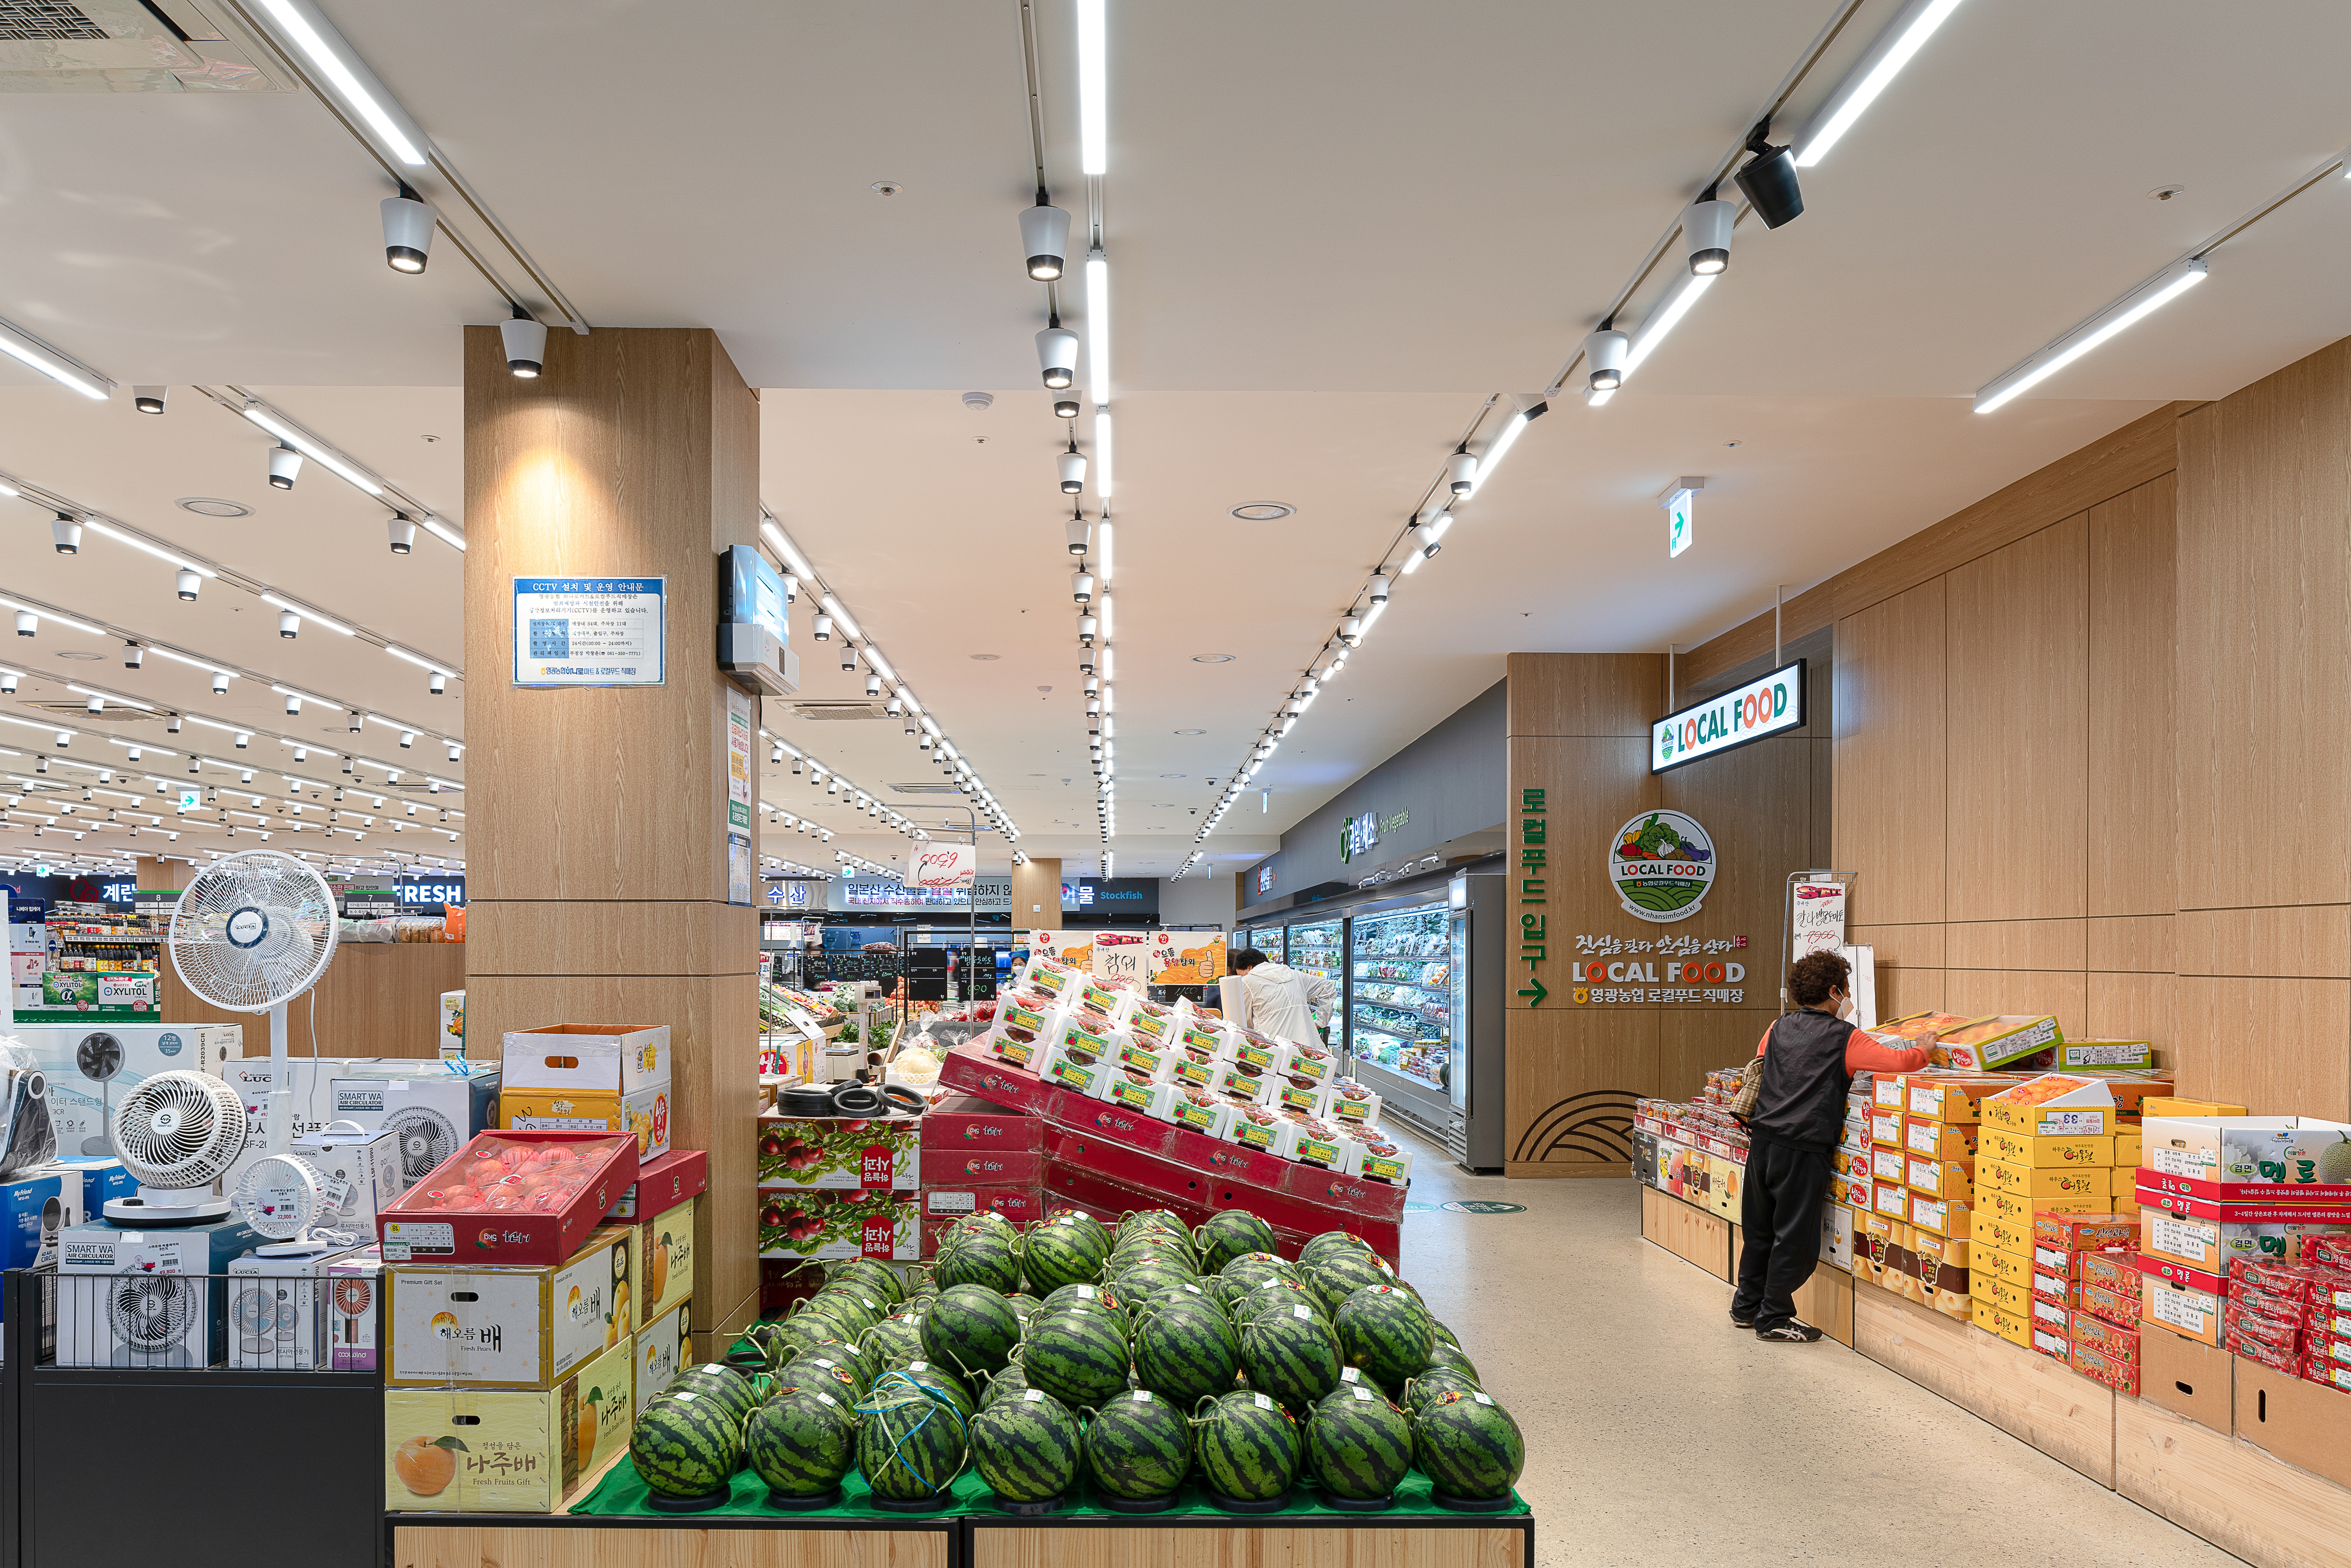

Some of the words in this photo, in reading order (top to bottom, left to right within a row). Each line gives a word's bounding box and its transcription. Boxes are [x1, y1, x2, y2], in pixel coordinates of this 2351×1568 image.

[562, 583, 578, 591] 설치
[596, 583, 612, 591] 운영
[618, 583, 644, 591] 안내문
[1679, 706, 1728, 752] LOCAL
[1734, 683, 1787, 732] FOOD
[1621, 864, 1664, 876] LOCAL
[1667, 864, 1706, 876] FOOD
[103, 884, 137, 902] 계란
[848, 884, 880, 895] 일본산
[1796, 885, 1842, 900] SALE
[1629, 904, 1696, 920] www.nhansimfood.kr
[1096, 933, 1144, 946] SALE
[1576, 934, 1623, 957] 진심을
[1624, 939, 1653, 953] 판다
[1656, 935, 1701, 957] 안심을
[1703, 939, 1733, 954] 산다
[1042, 947, 1055, 956] 으뜸
[1161, 948, 1175, 957] 으뜸
[1105, 953, 1136, 975] 참외
[1164, 958, 1195, 967] 용암참외
[1573, 961, 1659, 983] LOCAL
[1668, 961, 1745, 983] FOOD
[1591, 988, 1644, 1003] 영광농협
[1648, 989, 1701, 1002] 로컬푸드
[1703, 989, 1744, 1003] 직매장
[69, 1097, 102, 1106] 스탠드형
[984, 1126, 1002, 1135] 사과
[863, 1157, 889, 1171] 사과
[984, 1161, 1003, 1170] 사과
[864, 1173, 889, 1182] 하늘땅
[2177, 1200, 2191, 1213] 멜론
[484, 1233, 497, 1241] 5kg
[503, 1230, 529, 1244] 사과
[2096, 1228, 2130, 1237] 신선과일
[671, 1243, 689, 1269] 나주배
[2260, 1277, 2286, 1290] 방울토마토
[572, 1298, 589, 1320] 해오름
[590, 1287, 600, 1320] 배
[2311, 1293, 2332, 1303] 방울토마토
[2260, 1301, 2284, 1315] 방울토마토
[440, 1327, 476, 1340] 해오름
[479, 1324, 501, 1353] 배
[601, 1391, 627, 1426] 나주배
[467, 1452, 536, 1476] 나주배
